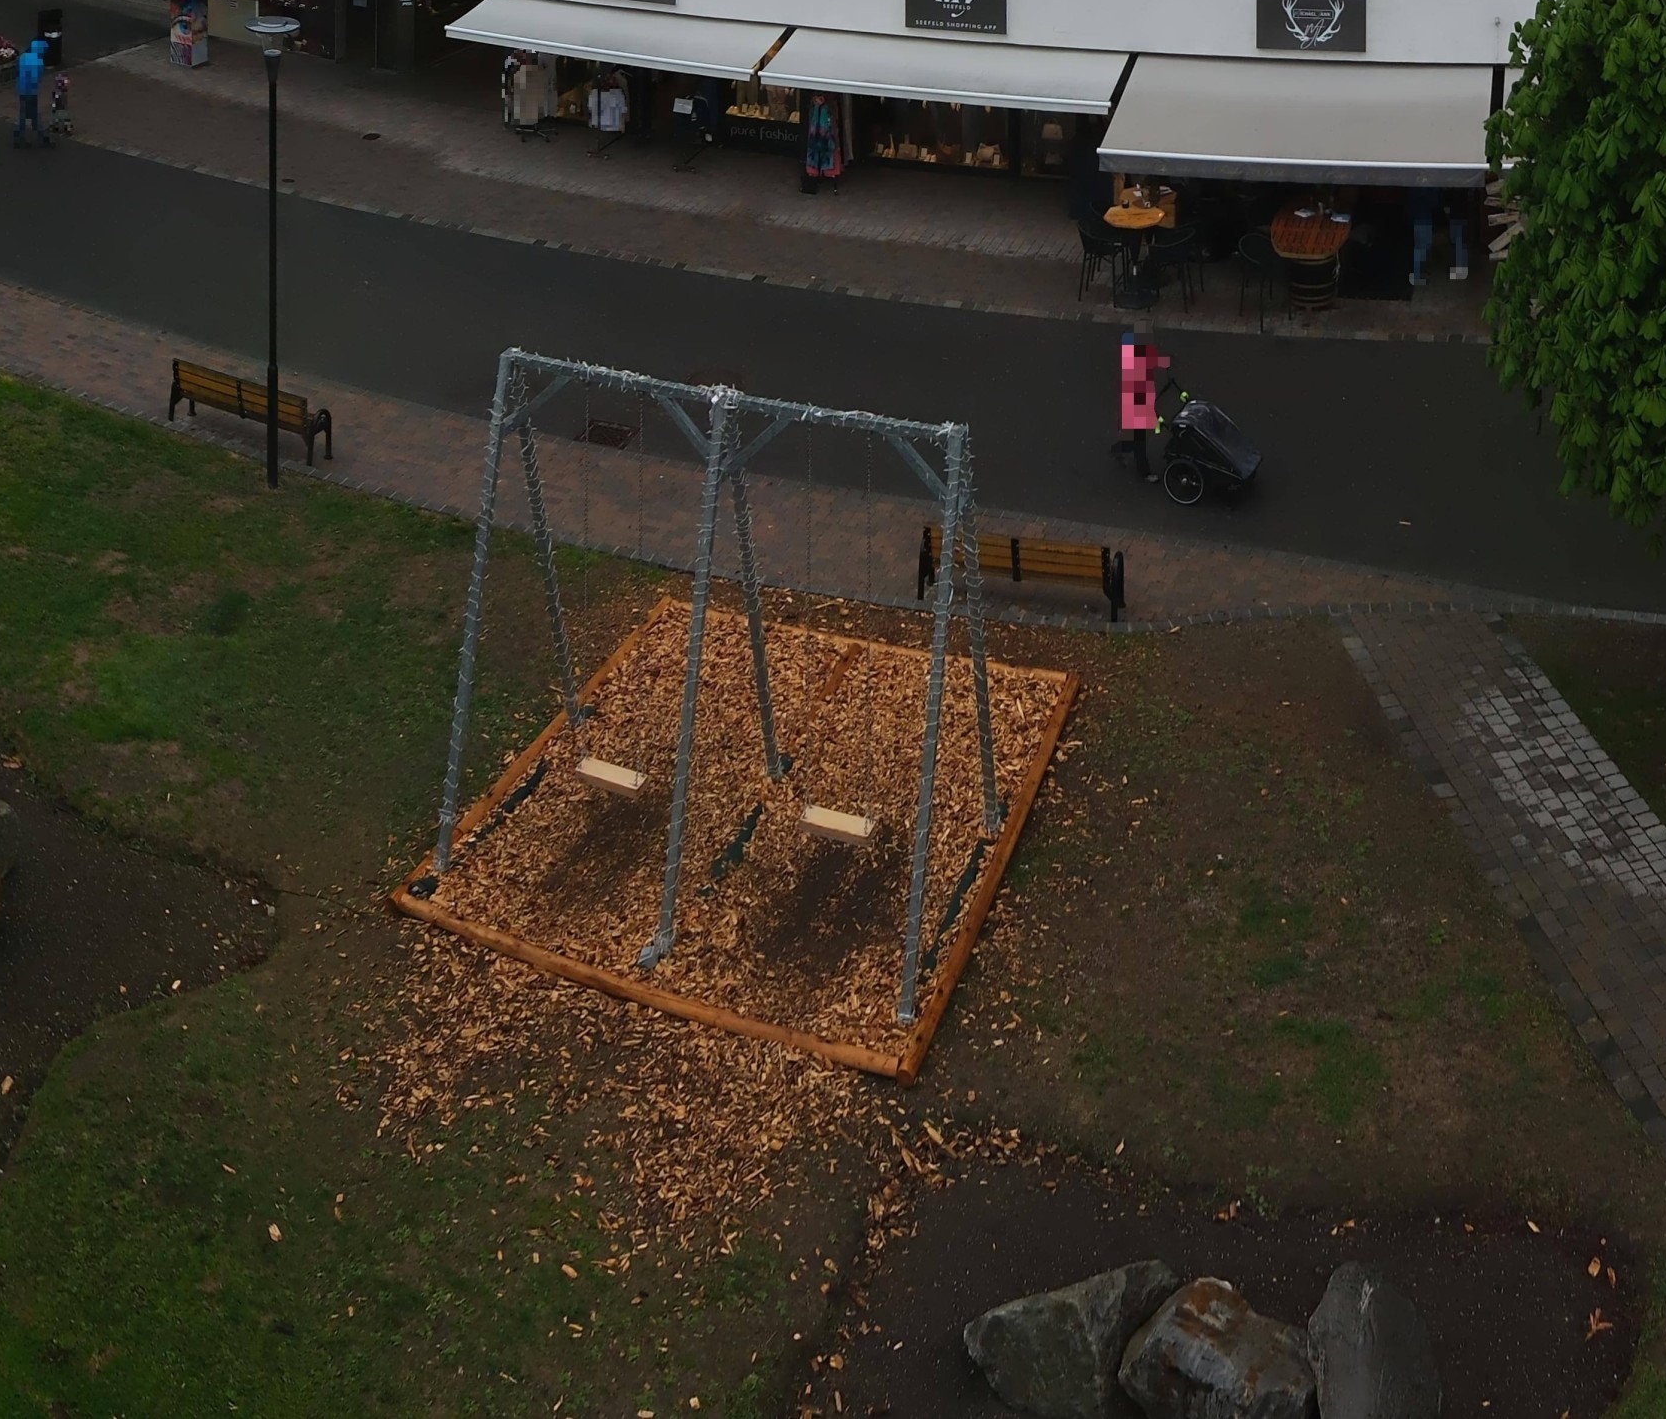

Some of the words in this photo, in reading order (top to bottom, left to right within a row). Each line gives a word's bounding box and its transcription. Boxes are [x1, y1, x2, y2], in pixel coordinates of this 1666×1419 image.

[942, 3, 972, 11] SEEFELD
[915, 19, 945, 27] SEEFELD
[946, 22, 982, 30] SHOPPING
[730, 126, 757, 137] pure
